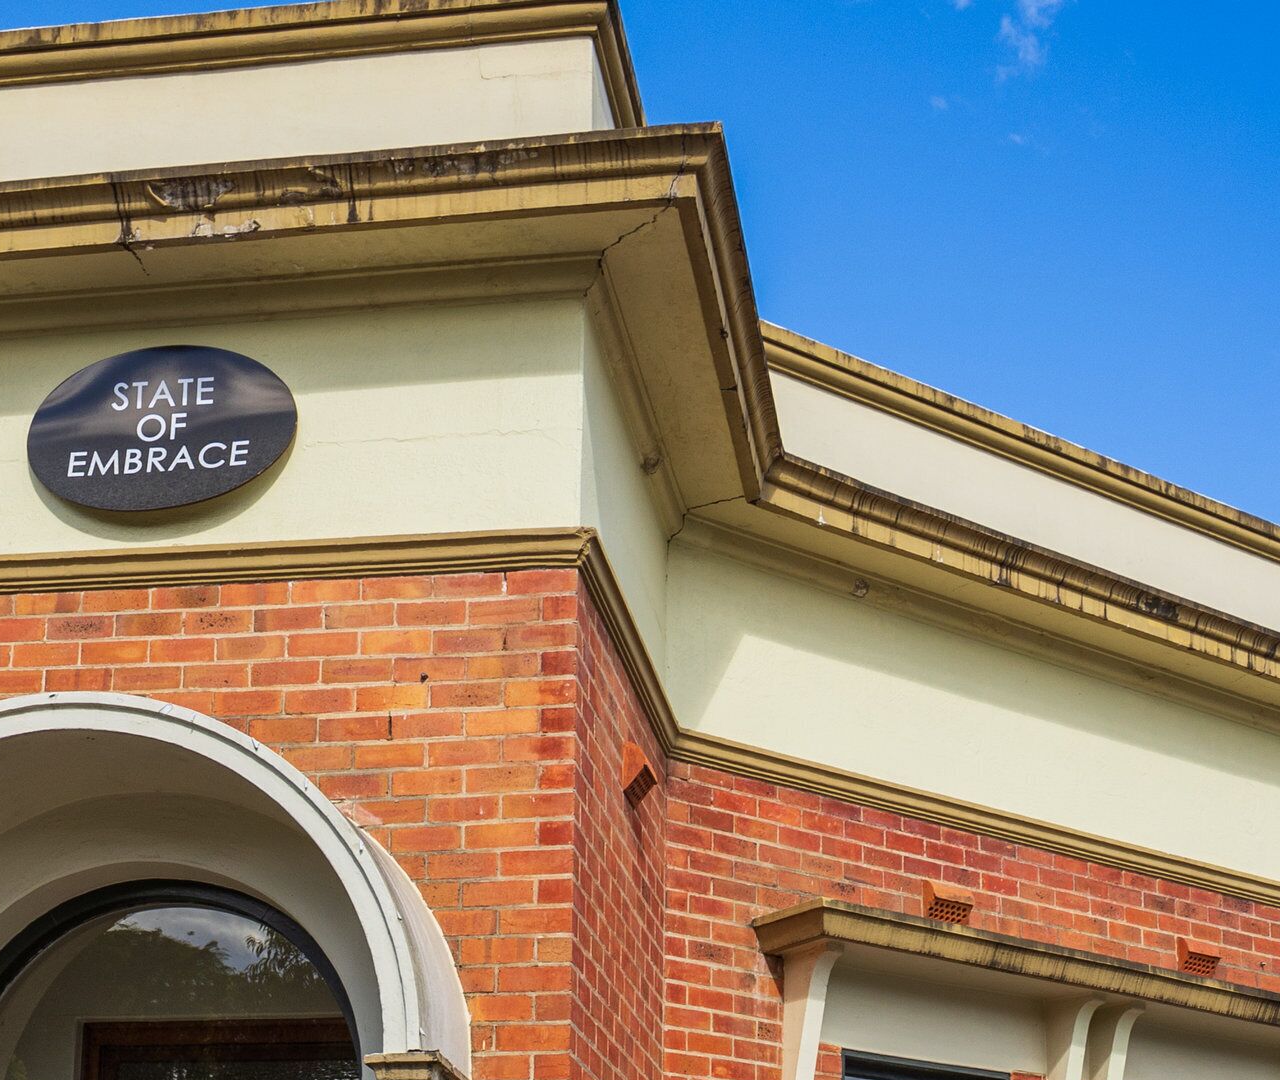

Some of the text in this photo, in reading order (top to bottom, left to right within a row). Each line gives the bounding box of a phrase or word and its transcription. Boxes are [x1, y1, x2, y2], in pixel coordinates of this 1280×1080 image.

[111, 376, 215, 411] STATE
[136, 413, 187, 442] OF
[67, 440, 250, 478] EMBRACE
